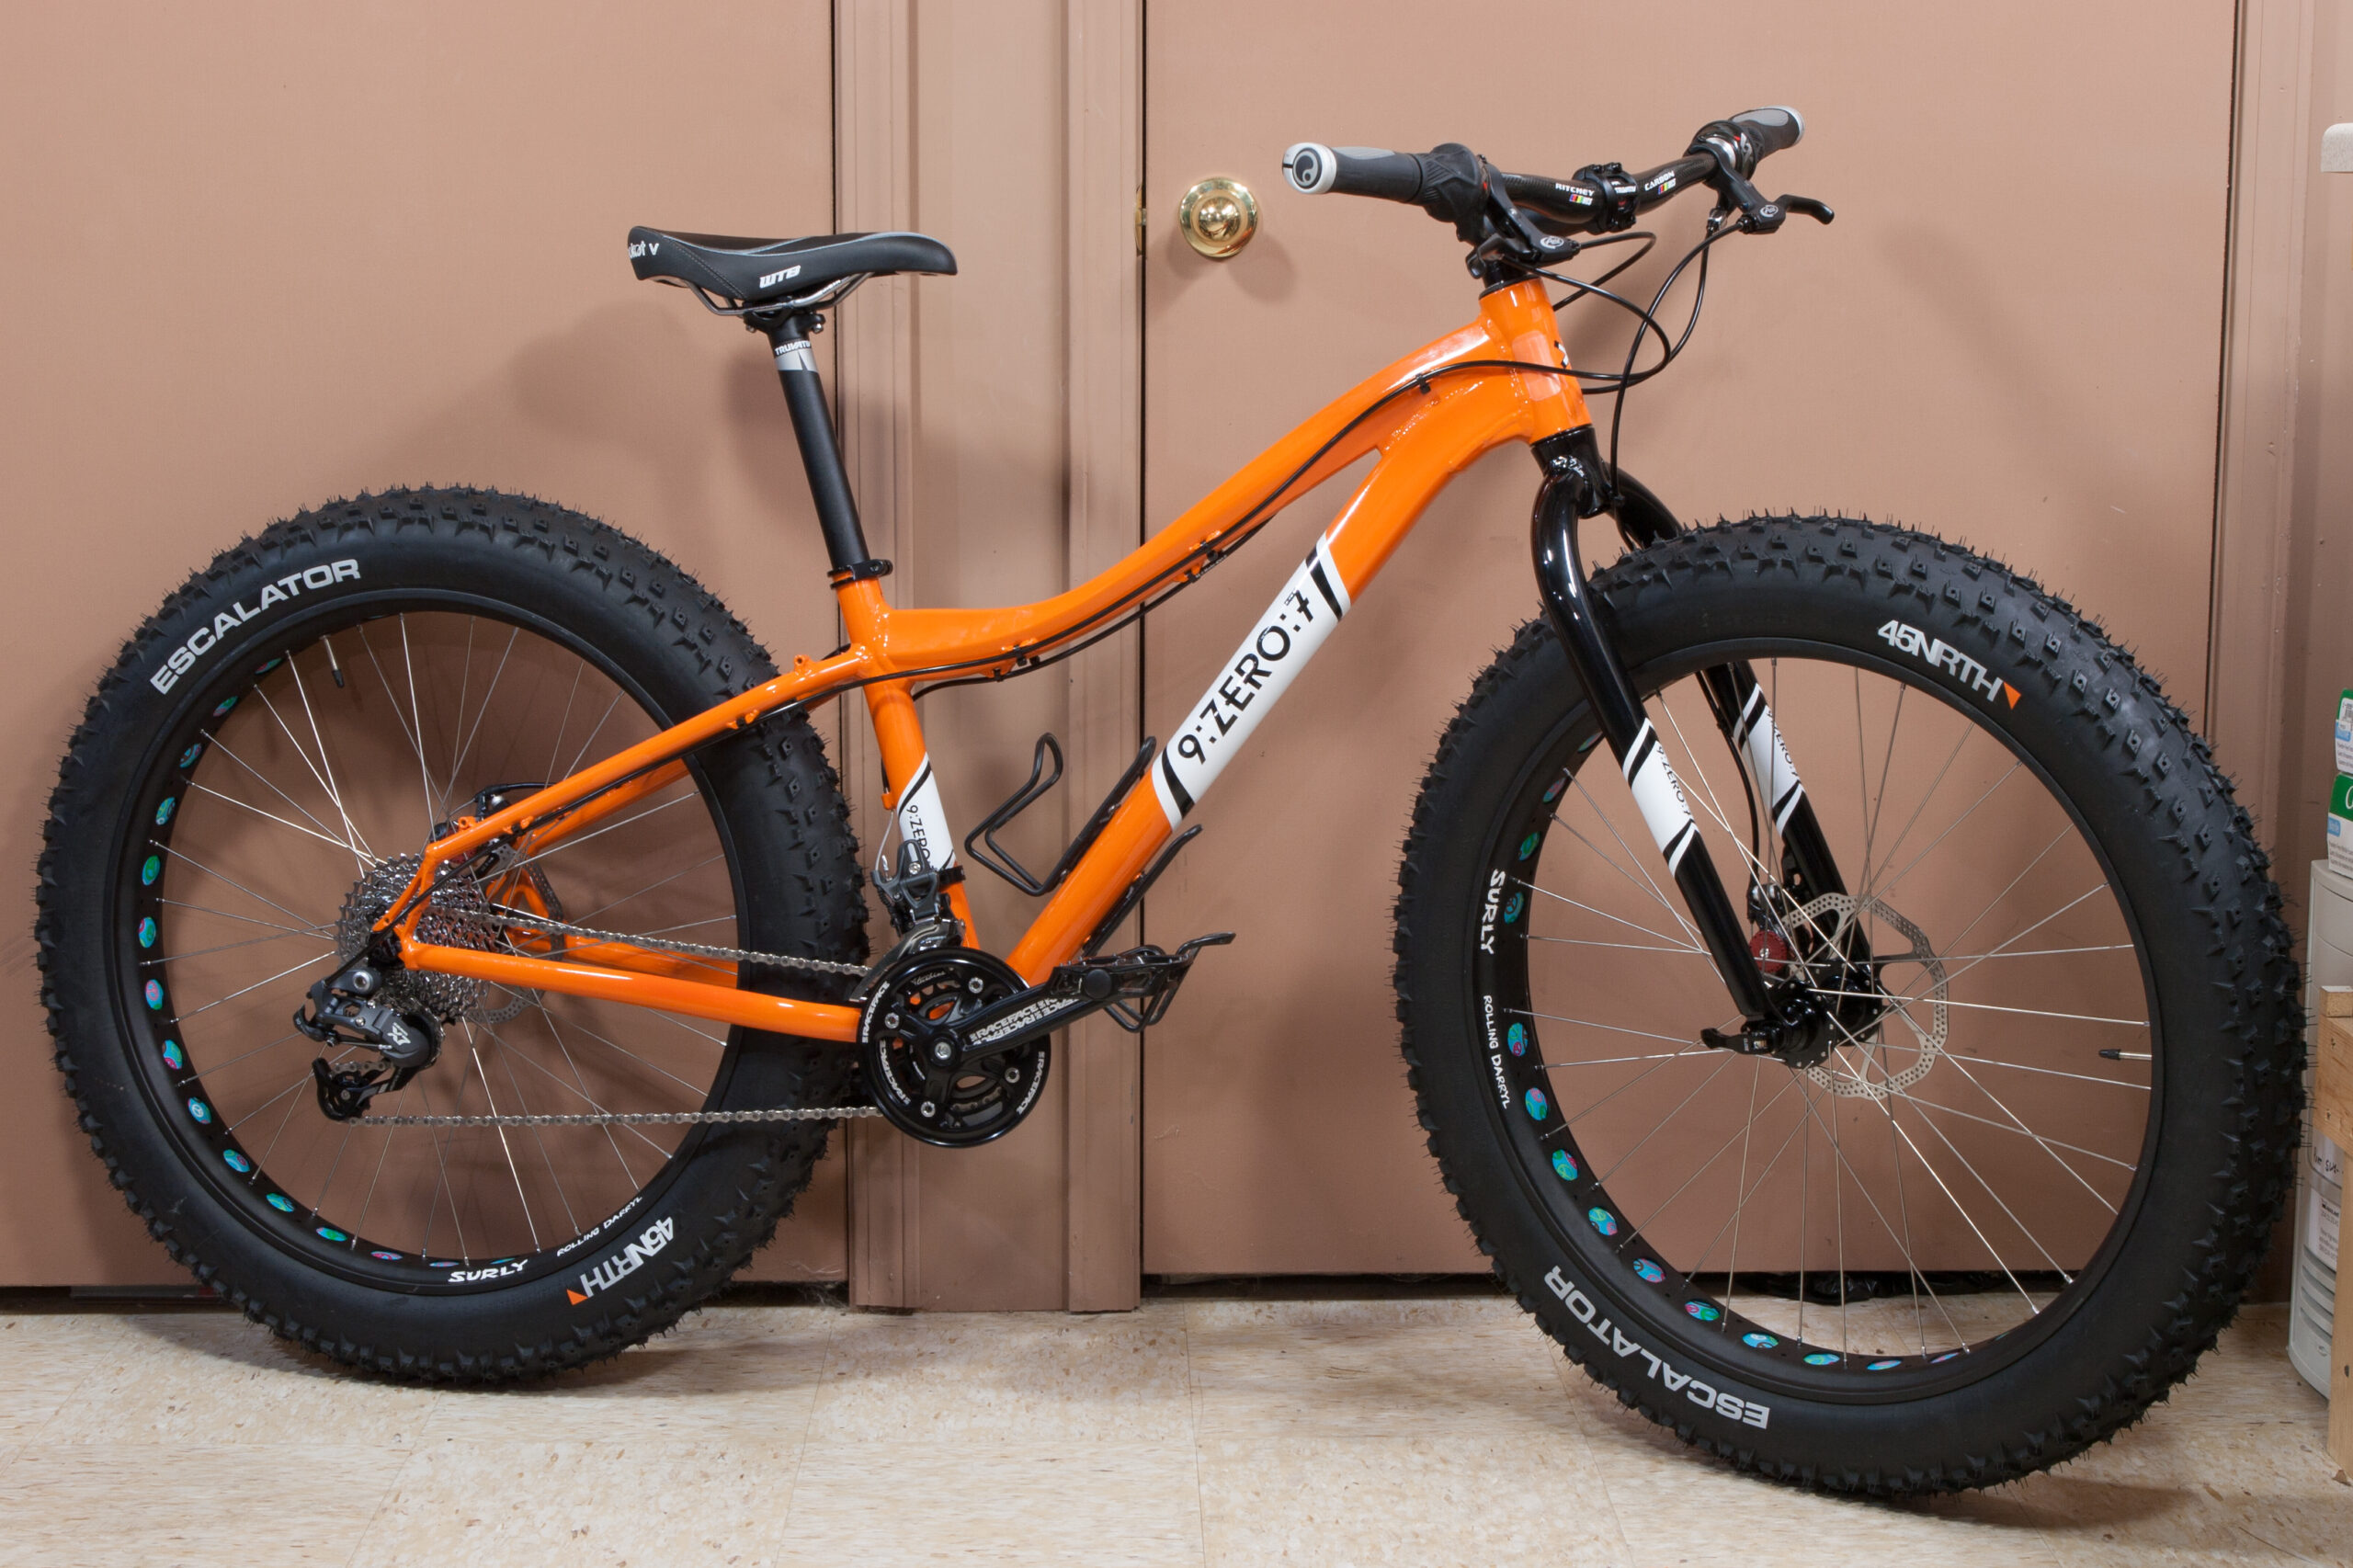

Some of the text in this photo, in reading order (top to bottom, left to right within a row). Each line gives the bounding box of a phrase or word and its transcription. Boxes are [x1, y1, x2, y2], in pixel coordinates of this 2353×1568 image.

[1555, 183, 1595, 197] RITCHEY
[1644, 170, 1675, 191] CARBON
[759, 265, 801, 289] WTB
[150, 559, 360, 695] ESCALATOR
[1878, 619, 2003, 702] 45NRTH
[1177, 590, 1313, 765] 9:ZERO:7
[1481, 869, 1506, 955] SURLY
[977, 1003, 1038, 1039] RACEFACE
[1483, 994, 1510, 1109] ROLLING DARRYL
[557, 1195, 642, 1256] ROLLING DARRYL
[580, 1217, 675, 1298] 45NRTH
[448, 1259, 529, 1283] SURLY
[1544, 1266, 1770, 1429] ESCALATOR
